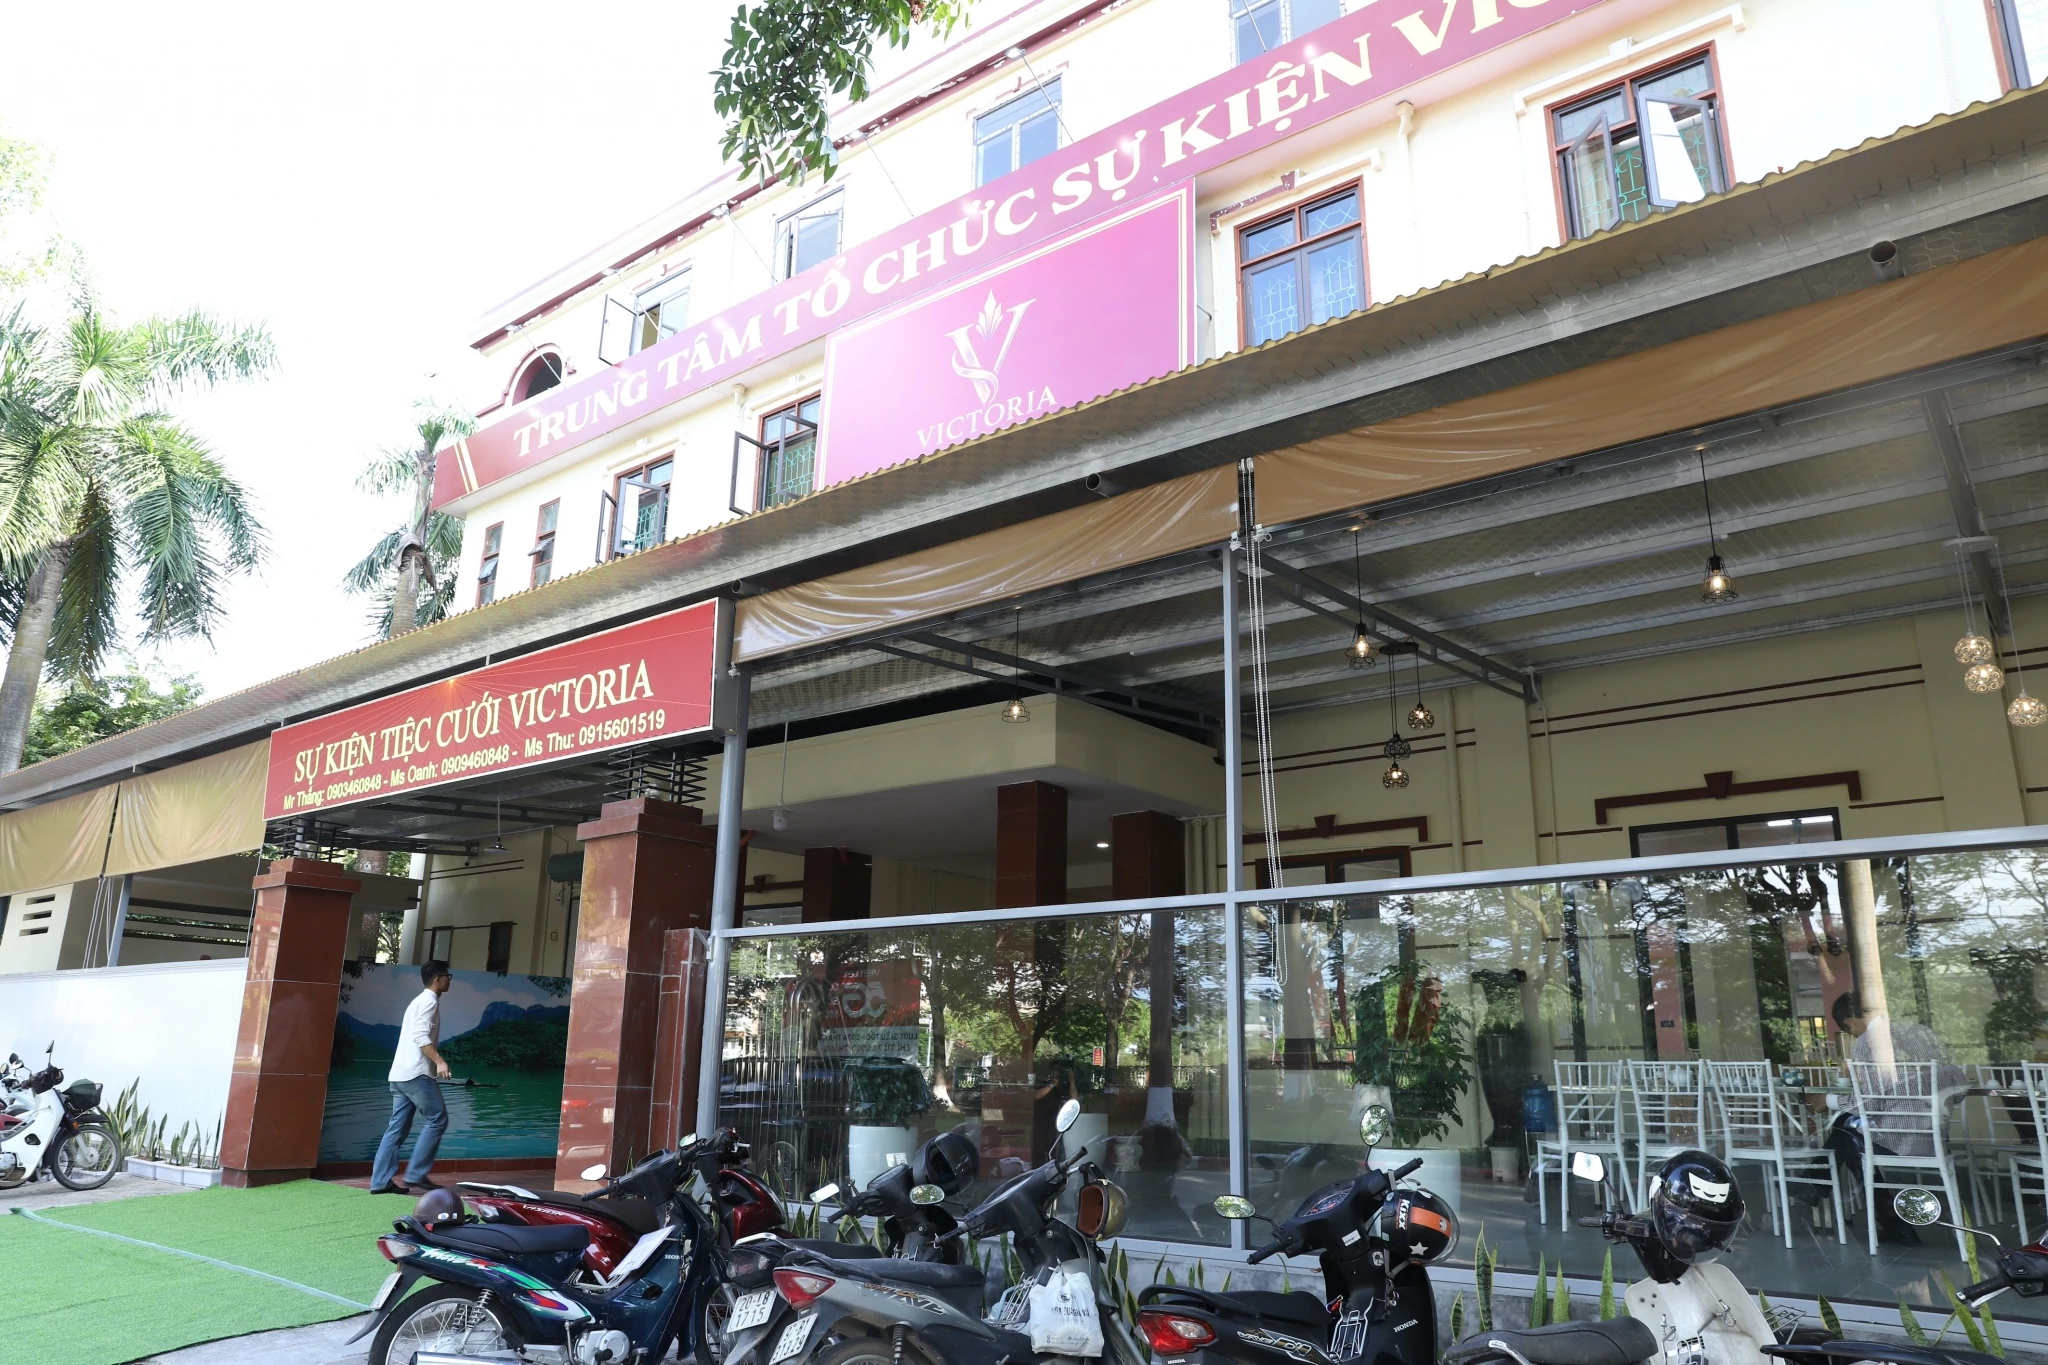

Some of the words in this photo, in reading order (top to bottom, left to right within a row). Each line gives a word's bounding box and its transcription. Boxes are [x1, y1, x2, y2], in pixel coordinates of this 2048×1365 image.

[513, 368, 650, 458] TRUNG
[657, 314, 763, 390] TÂM
[774, 256, 851, 337] TỔ
[862, 187, 1038, 296] CHỨC
[1052, 129, 1148, 216] SỰ
[1160, 32, 1373, 168] KIỆN
[1391, 0, 1550, 56] VI
[916, 385, 1058, 449] VICTORIA
[283, 794, 295, 811] Mr
[327, 773, 382, 801] 0903460848
[391, 769, 406, 788] Ms
[407, 763, 439, 783] Oanh:
[441, 744, 510, 777] 0909460848
[524, 736, 544, 759] Ms
[546, 731, 575, 753] Thu:
[578, 708, 666, 747] 0915601519
[294, 743, 325, 785] SỰ
[323, 732, 377, 777] KIỆN
[380, 717, 432, 764] TIỆC
[435, 691, 503, 748] CƯỚI
[507, 658, 655, 730] VICTORIA
[735, 1306, 766, 1328] 1715
[1393, 1319, 1418, 1333] HONDA
